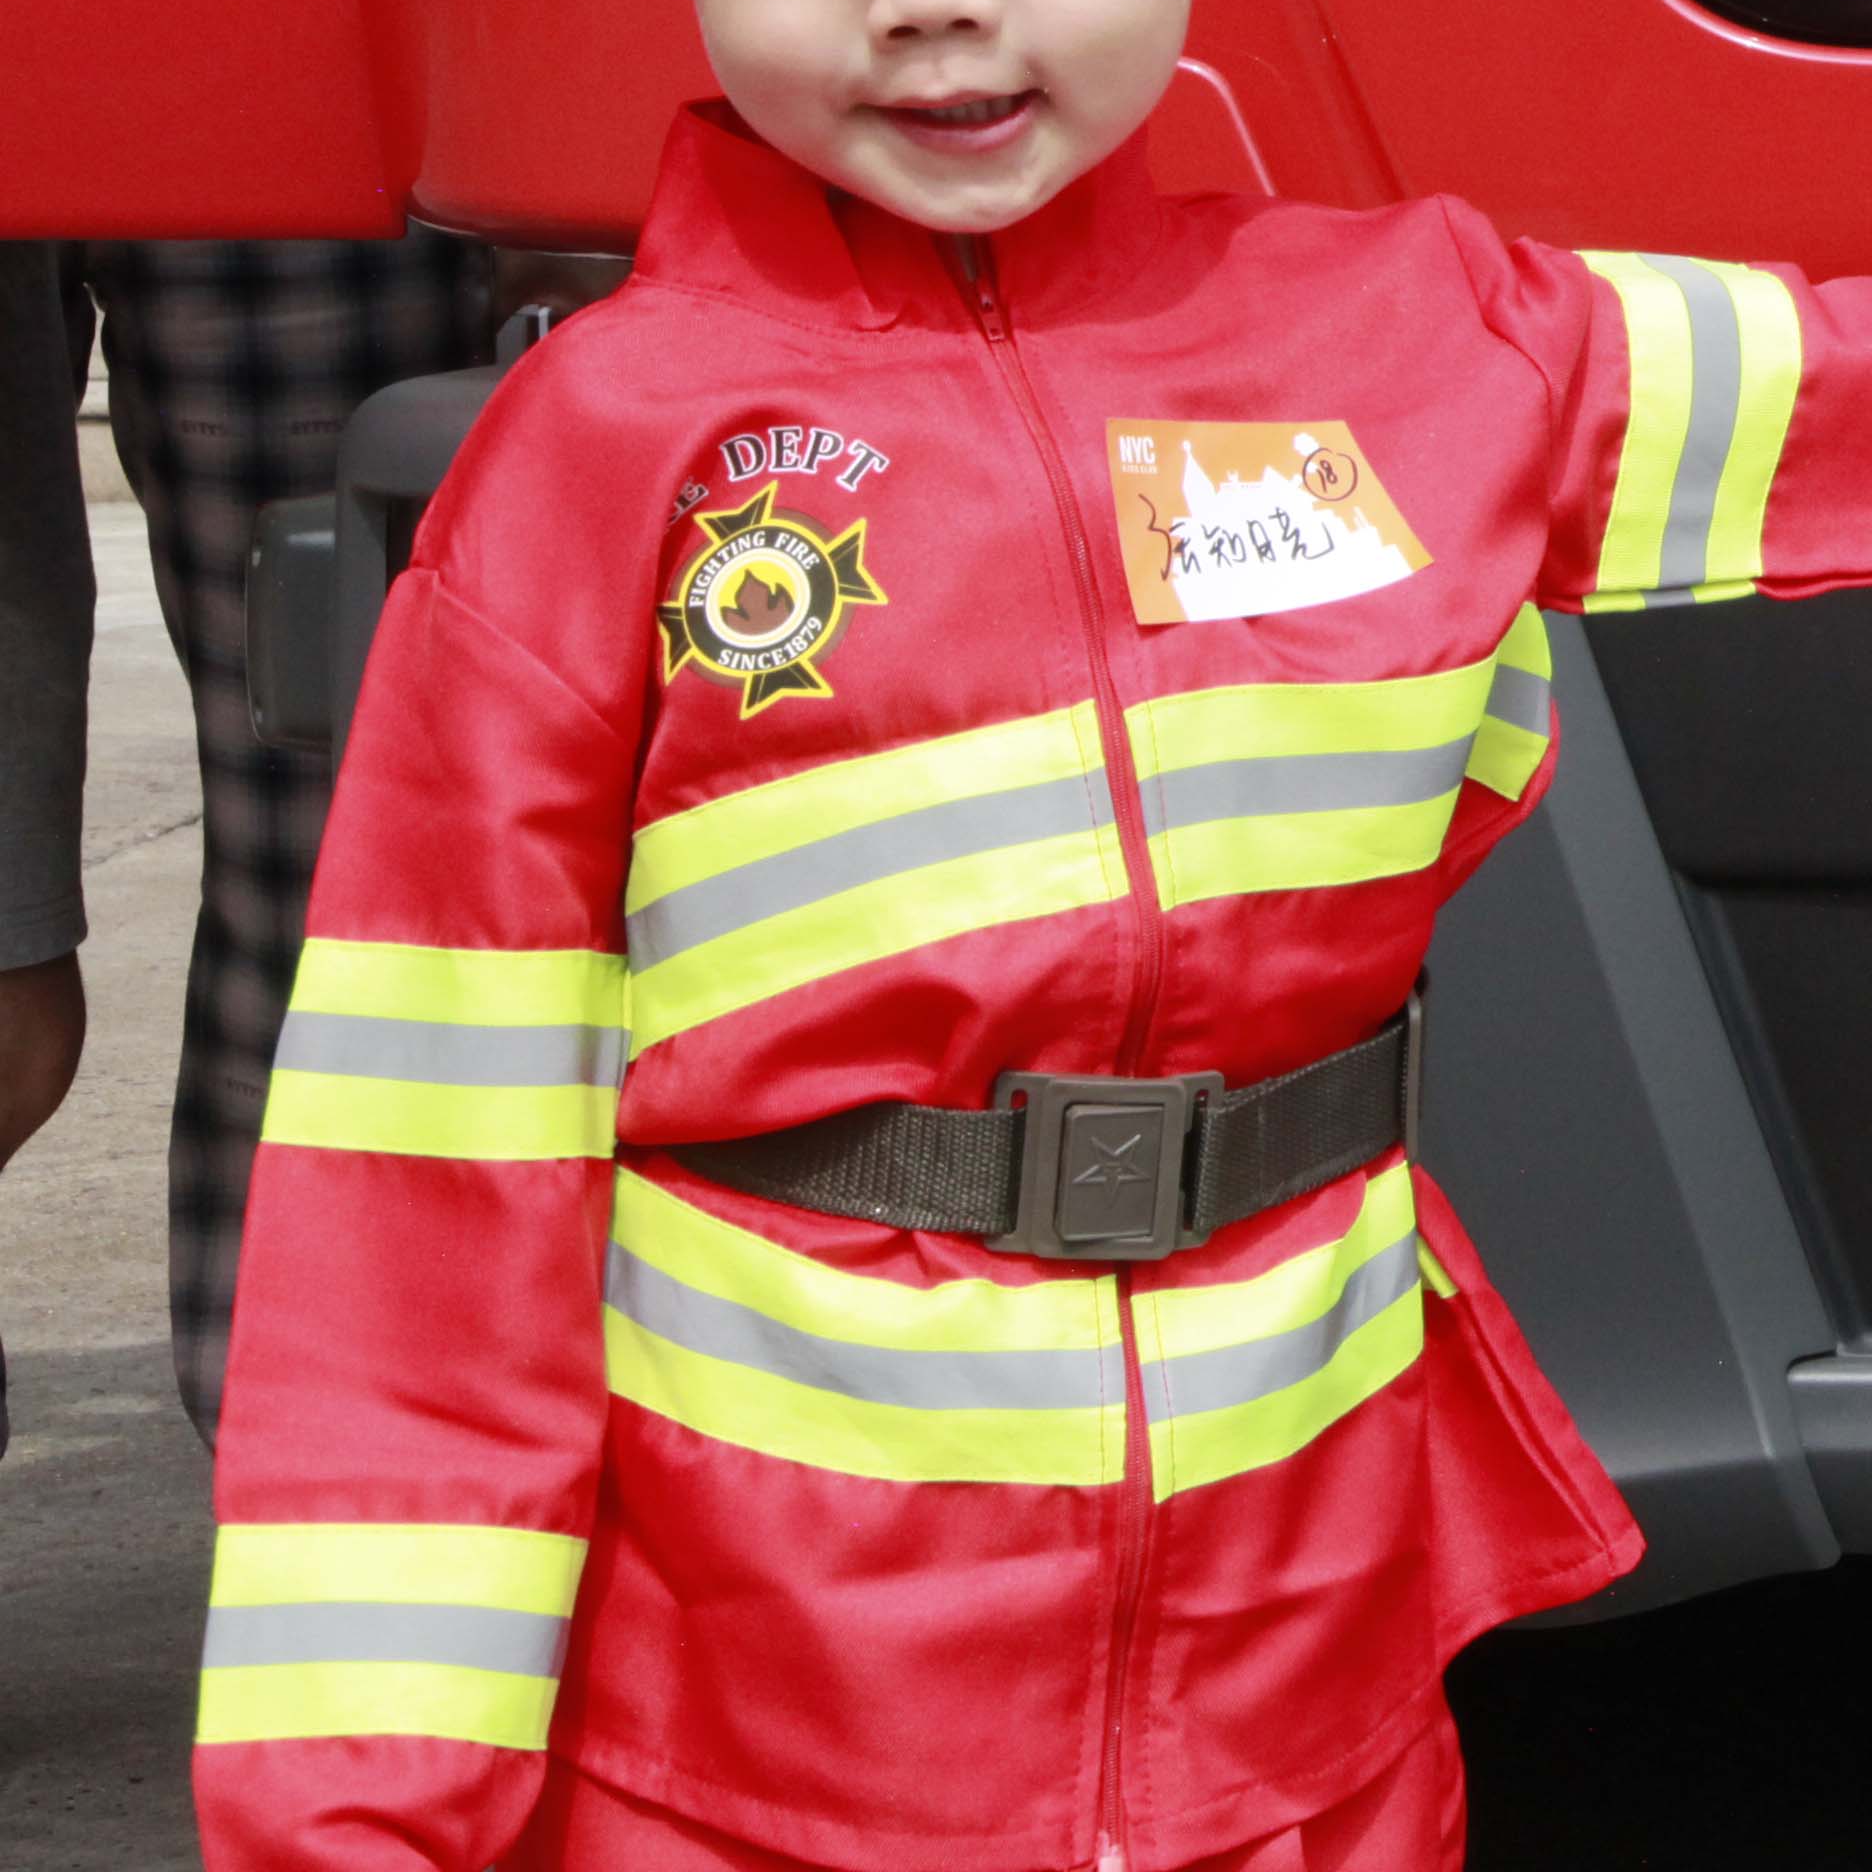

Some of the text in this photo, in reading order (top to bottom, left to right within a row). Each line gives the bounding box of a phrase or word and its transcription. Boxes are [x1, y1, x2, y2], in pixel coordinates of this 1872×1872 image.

[720, 426, 890, 492] DEPT
[1119, 435, 1156, 464] NYC
[688, 530, 820, 608] FIGHTING FIRE
